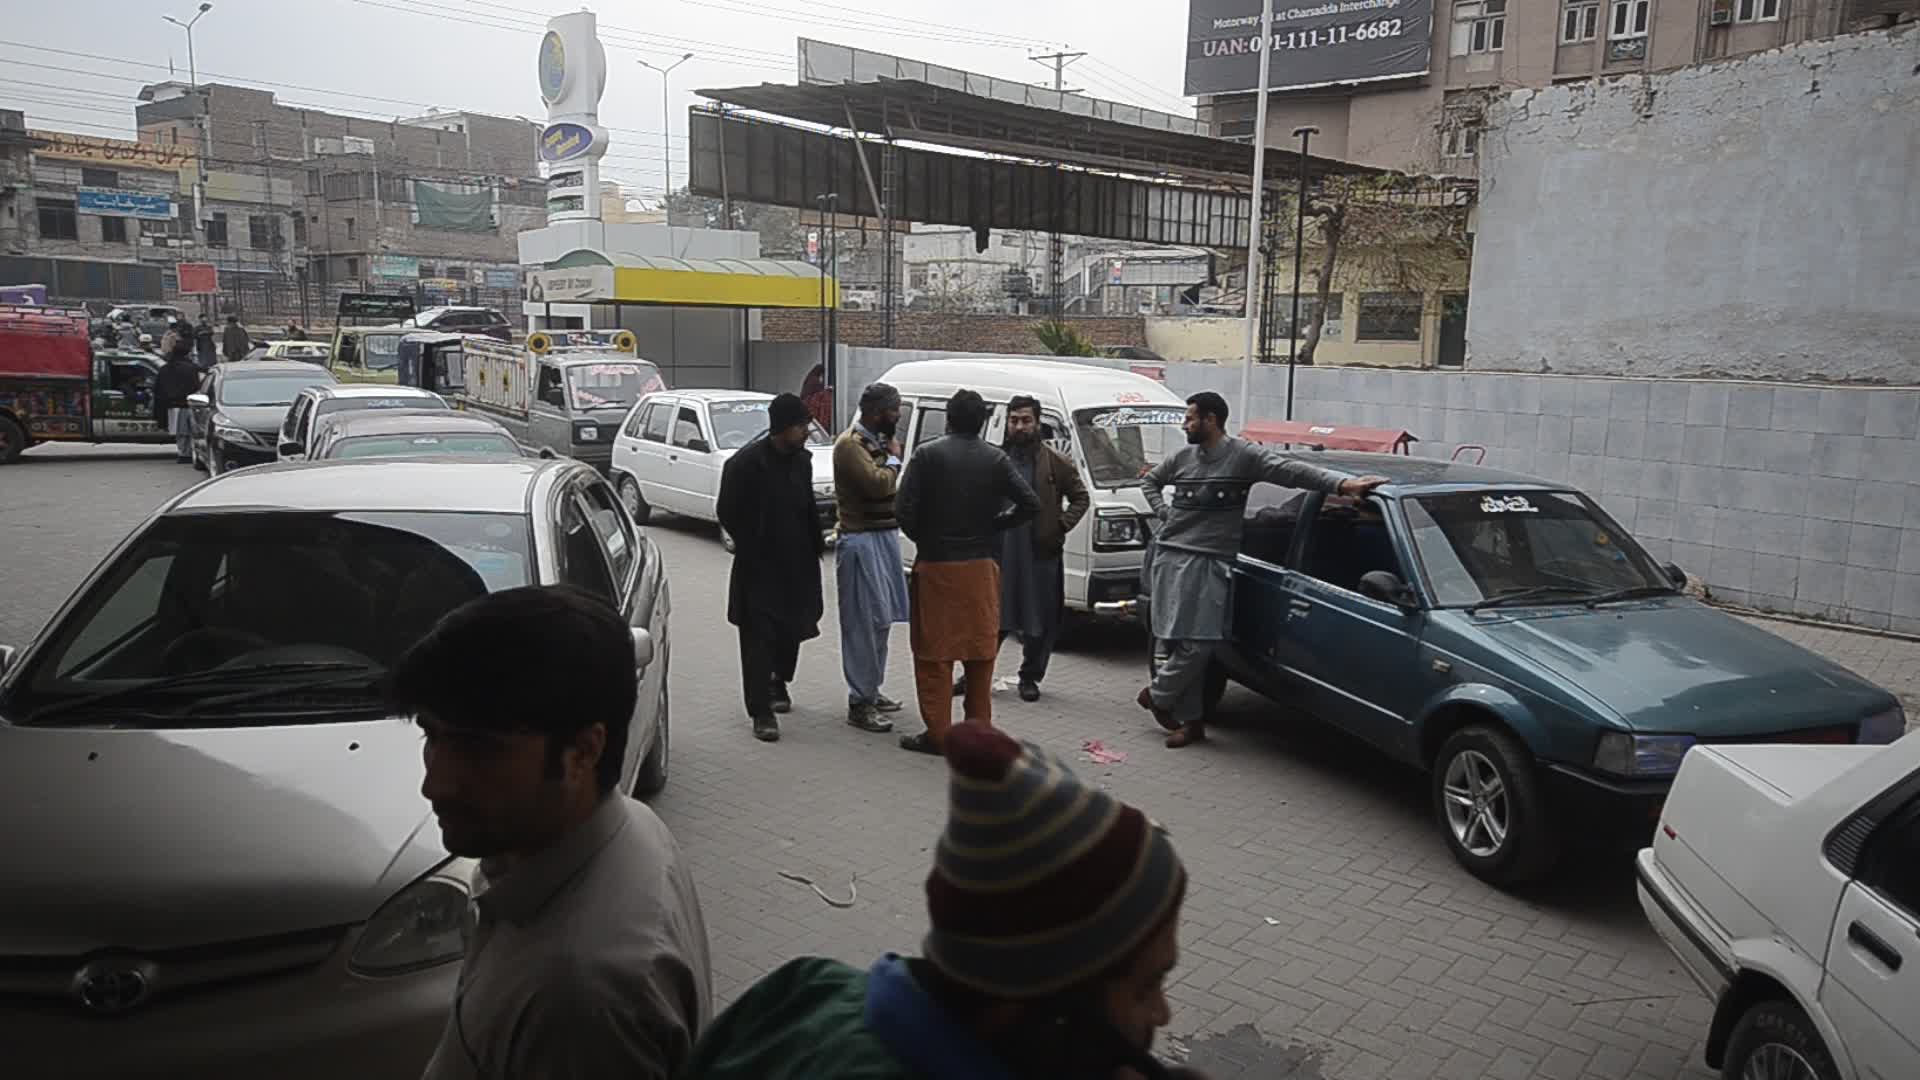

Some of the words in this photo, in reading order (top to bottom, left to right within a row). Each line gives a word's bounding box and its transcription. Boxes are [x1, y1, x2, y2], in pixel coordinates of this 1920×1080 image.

[1213, 15, 1260, 29] Motorway
[1275, 11, 1286, 21] at
[1286, 2, 1338, 20] Charsadda
[1203, 38, 1249, 57] UAN:
[1249, 18, 1402, 53] 01-111-11-6682
